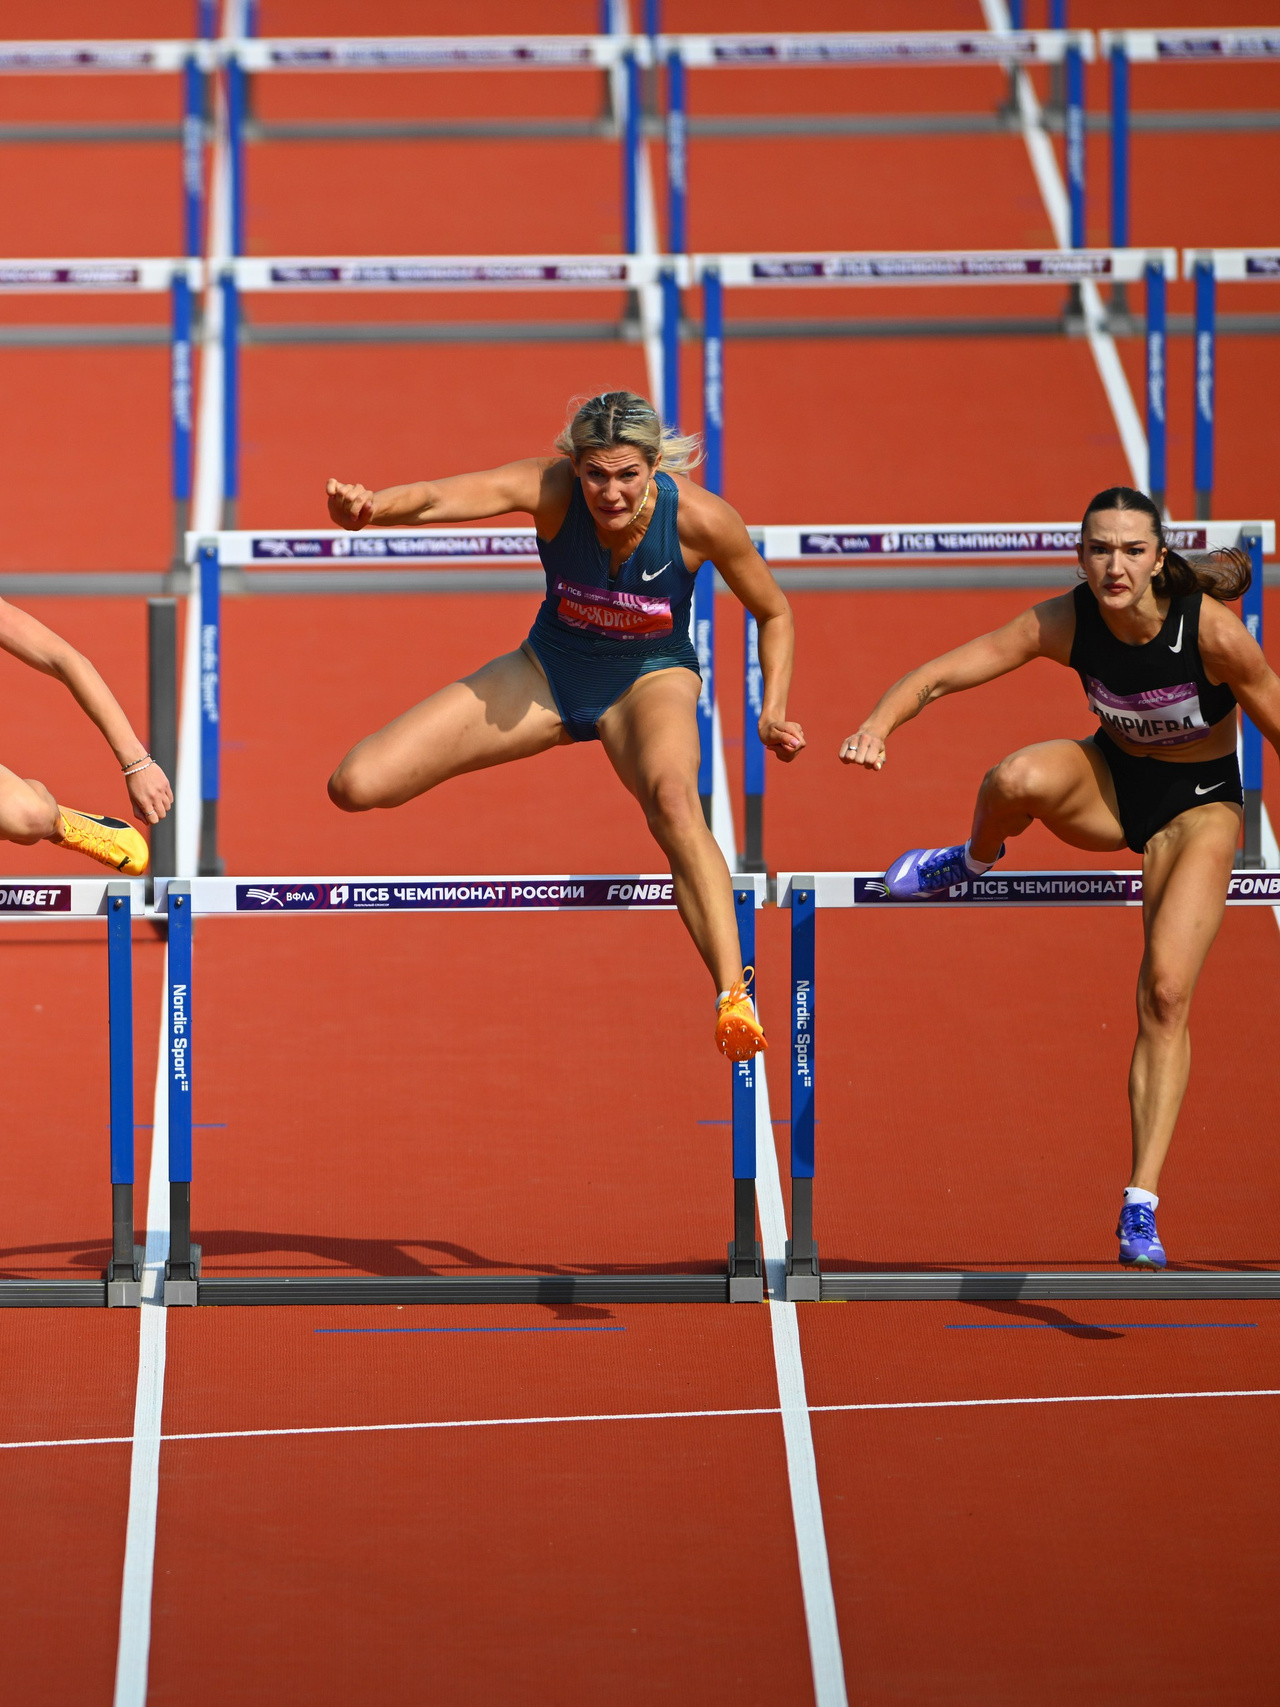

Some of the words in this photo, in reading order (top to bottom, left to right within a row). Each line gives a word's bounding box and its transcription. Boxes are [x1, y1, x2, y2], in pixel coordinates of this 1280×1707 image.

[938, 532, 1038, 548] ЧЕМПИОНАТ
[286, 892, 316, 902] ВФЛА
[353, 887, 390, 902] ПСБ
[393, 886, 507, 901] ЧЕМПИОНАТ
[511, 885, 586, 900] РОССИИ
[606, 884, 674, 900] FONBE
[972, 881, 1009, 896] ПСБ
[1013, 879, 1127, 895] ЧЕМПИОНАТ
[172, 984, 188, 1034] Nordic
[796, 980, 811, 1030] Nordic
[170, 1037, 188, 1080] Sport
[794, 1034, 811, 1076] Sport
